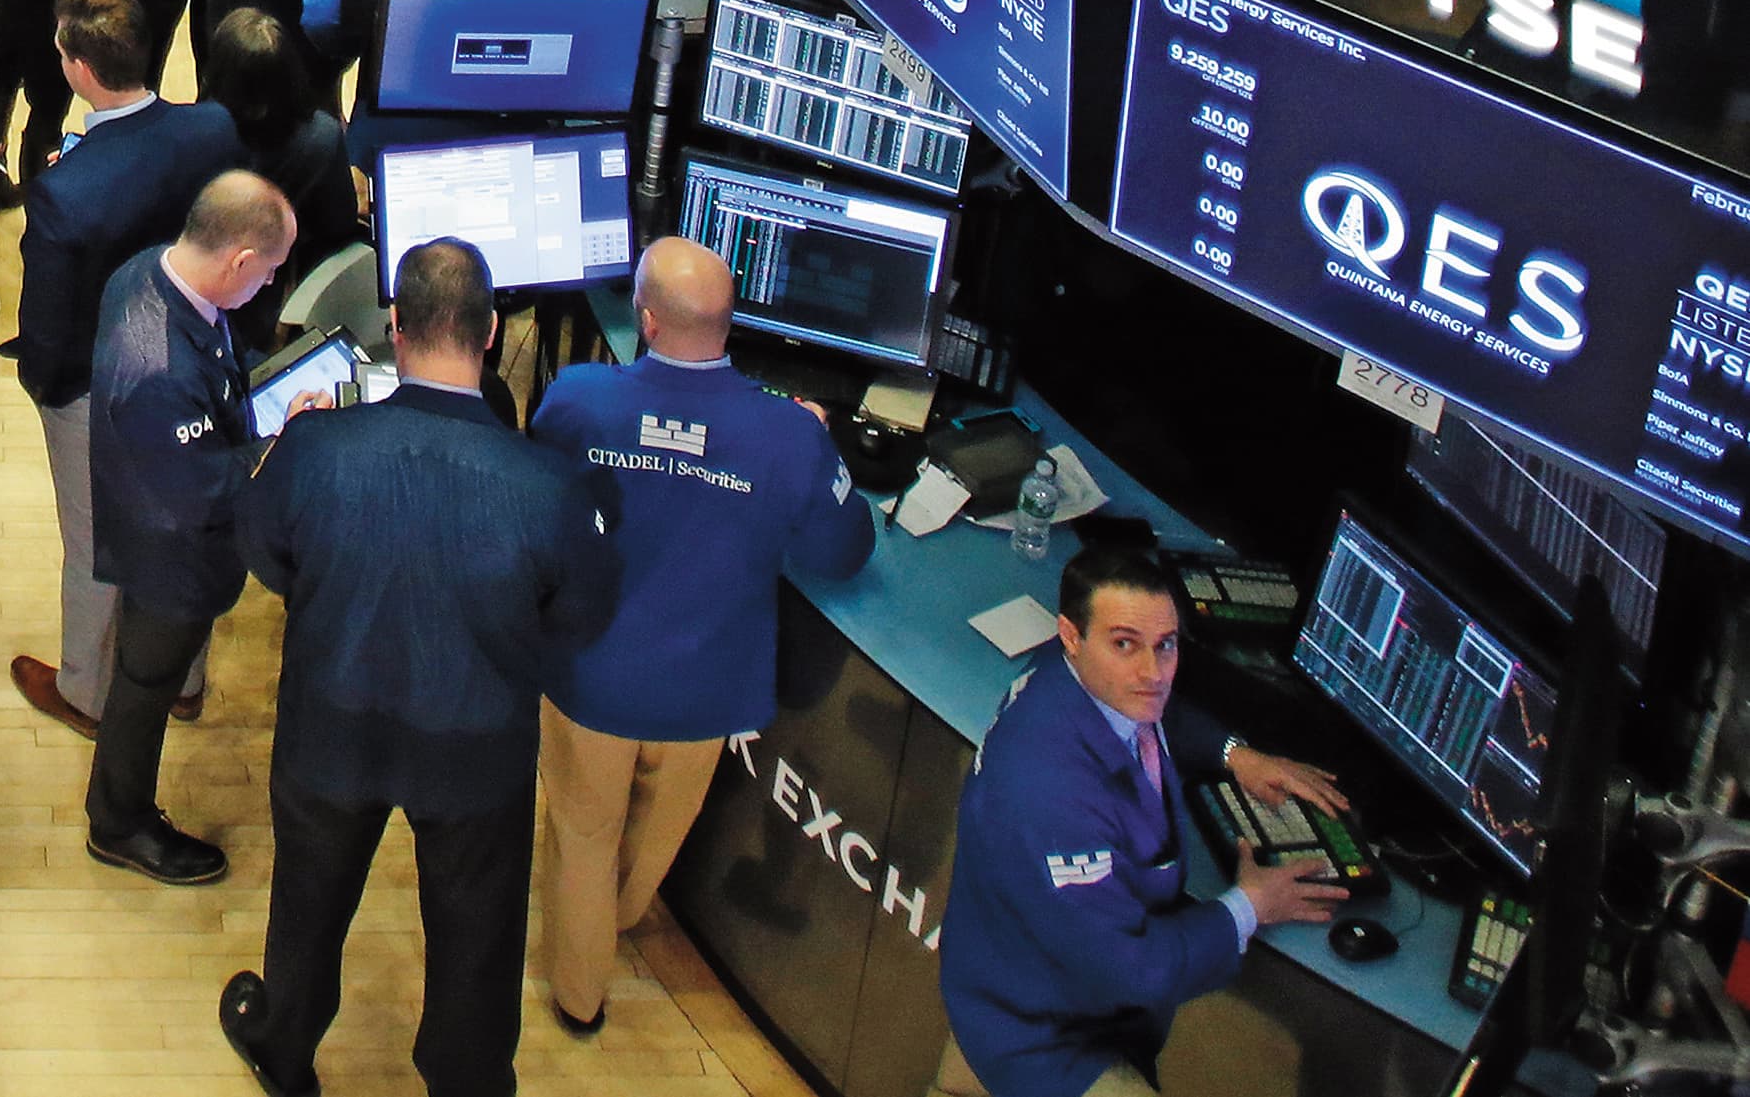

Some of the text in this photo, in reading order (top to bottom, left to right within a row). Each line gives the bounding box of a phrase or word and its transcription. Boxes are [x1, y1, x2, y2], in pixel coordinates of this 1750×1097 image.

[1272, 11, 1335, 47] Services
[1338, 38, 1367, 61] Inc.
[889, 40, 926, 82] 2499
[1171, 43, 1256, 92] 9,259,259
[1201, 104, 1250, 138] 10.00
[1205, 155, 1244, 182] 0.00
[1200, 197, 1238, 225] 0.00
[1194, 239, 1232, 268] 0.00
[1304, 171, 1585, 352] QES
[1326, 260, 1550, 375] QUINTANA ENERGY SERVICES
[1657, 363, 1689, 386] BofA
[1670, 328, 1750, 384] NYS
[1354, 358, 1430, 409] 2778
[176, 415, 214, 444] 904
[1647, 413, 1725, 456] Piper Jaffray
[1651, 389, 1744, 439] Simmons & Co.
[588, 447, 752, 494] CITADEL Securities
[1637, 459, 1741, 516] Citadel Securities
[772, 757, 942, 951] EXCH
